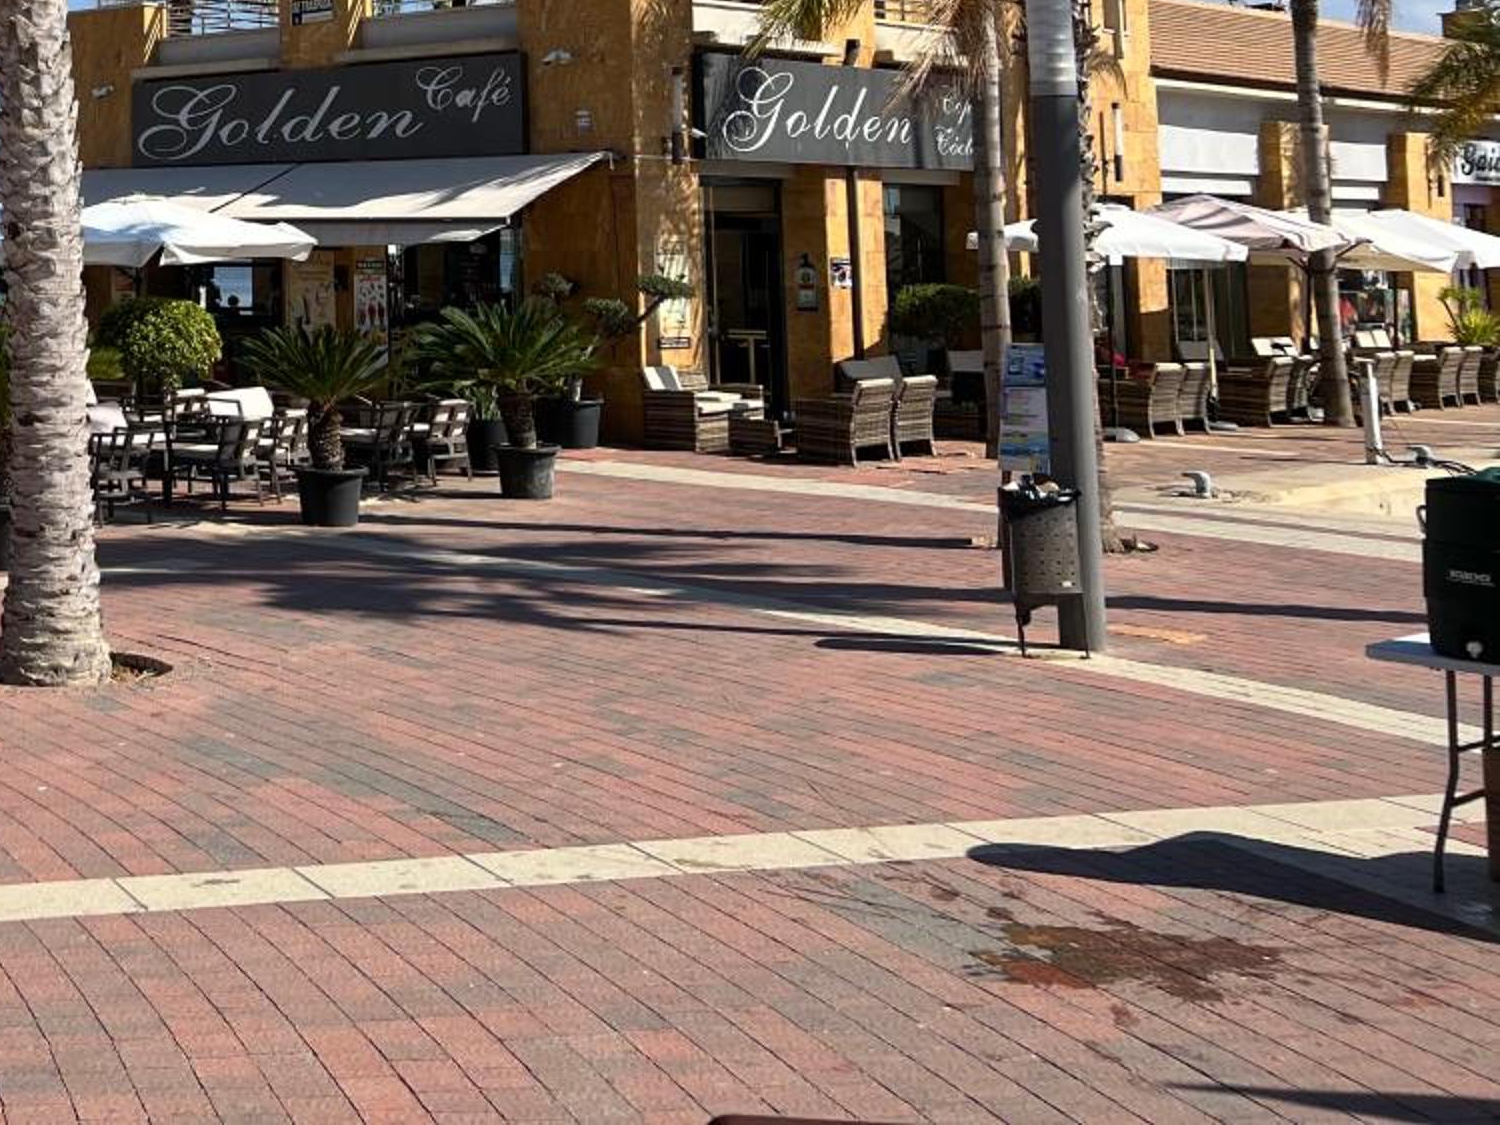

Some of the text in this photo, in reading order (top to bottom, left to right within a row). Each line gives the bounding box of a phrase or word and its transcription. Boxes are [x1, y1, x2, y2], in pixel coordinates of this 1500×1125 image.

[138, 66, 511, 160] Golden Café
[722, 66, 912, 152] Golden
